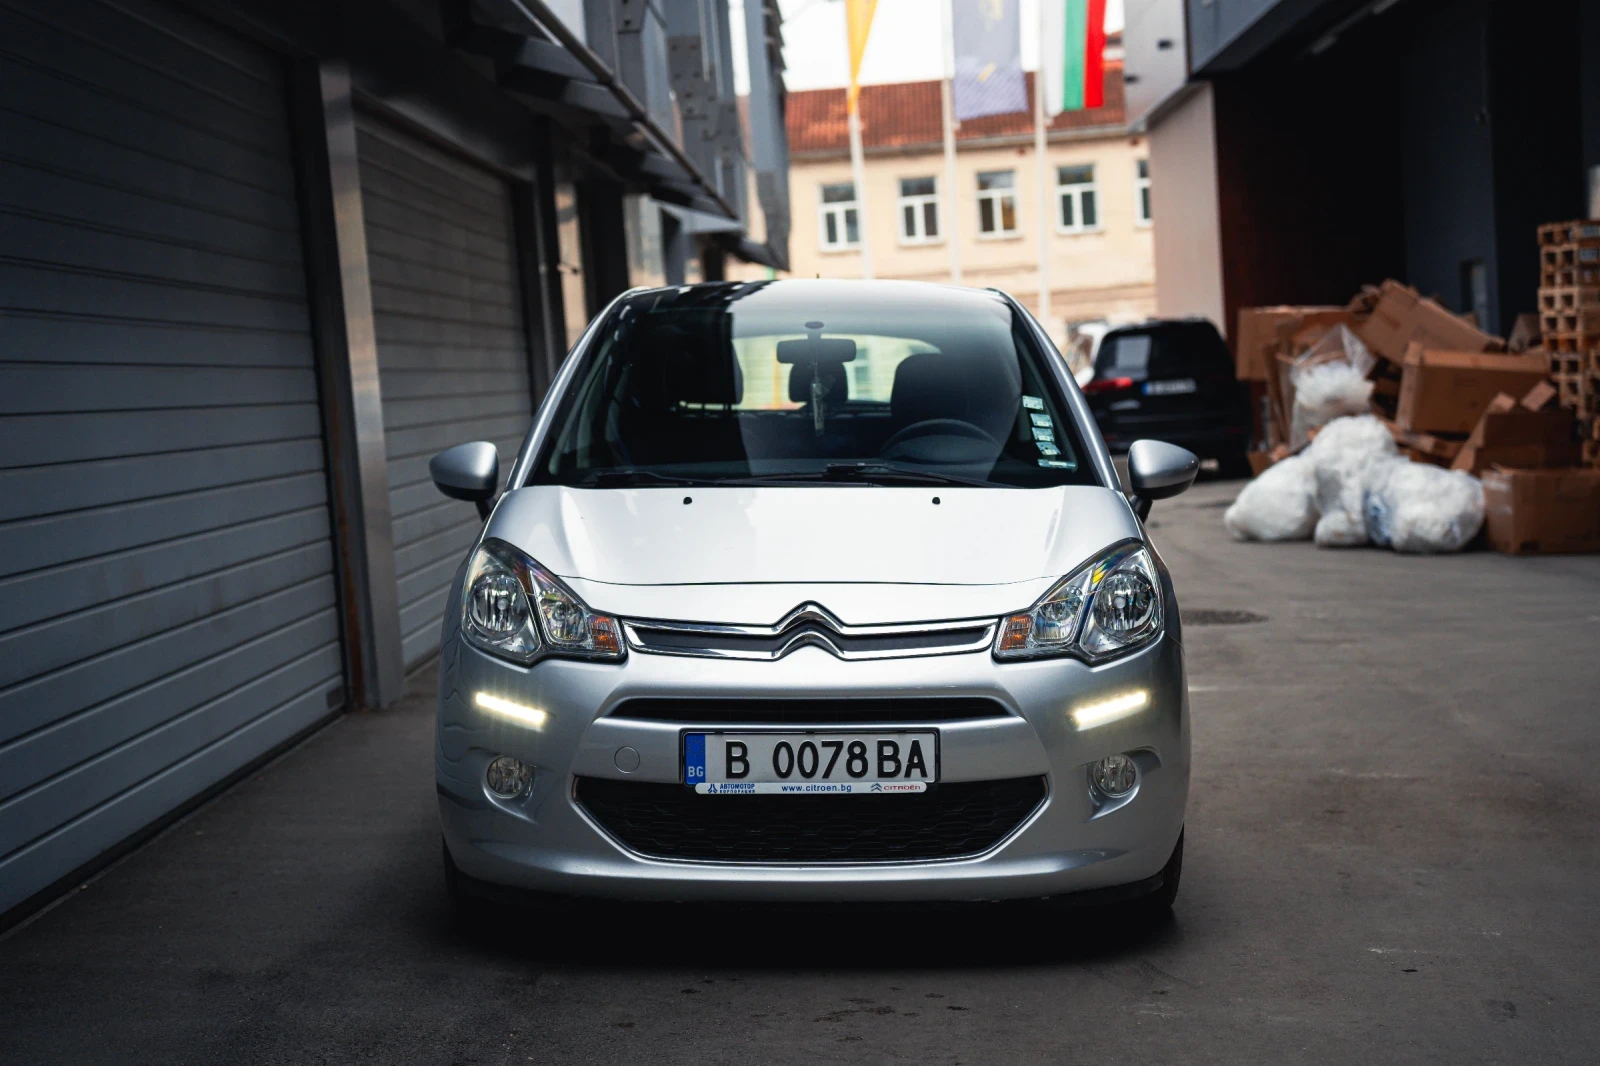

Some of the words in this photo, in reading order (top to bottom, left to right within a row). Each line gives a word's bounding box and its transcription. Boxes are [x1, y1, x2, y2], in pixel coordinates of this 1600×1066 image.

[725, 740, 750, 779] B
[688, 766, 704, 777] BG
[781, 783, 852, 793] www.citroen.bg
